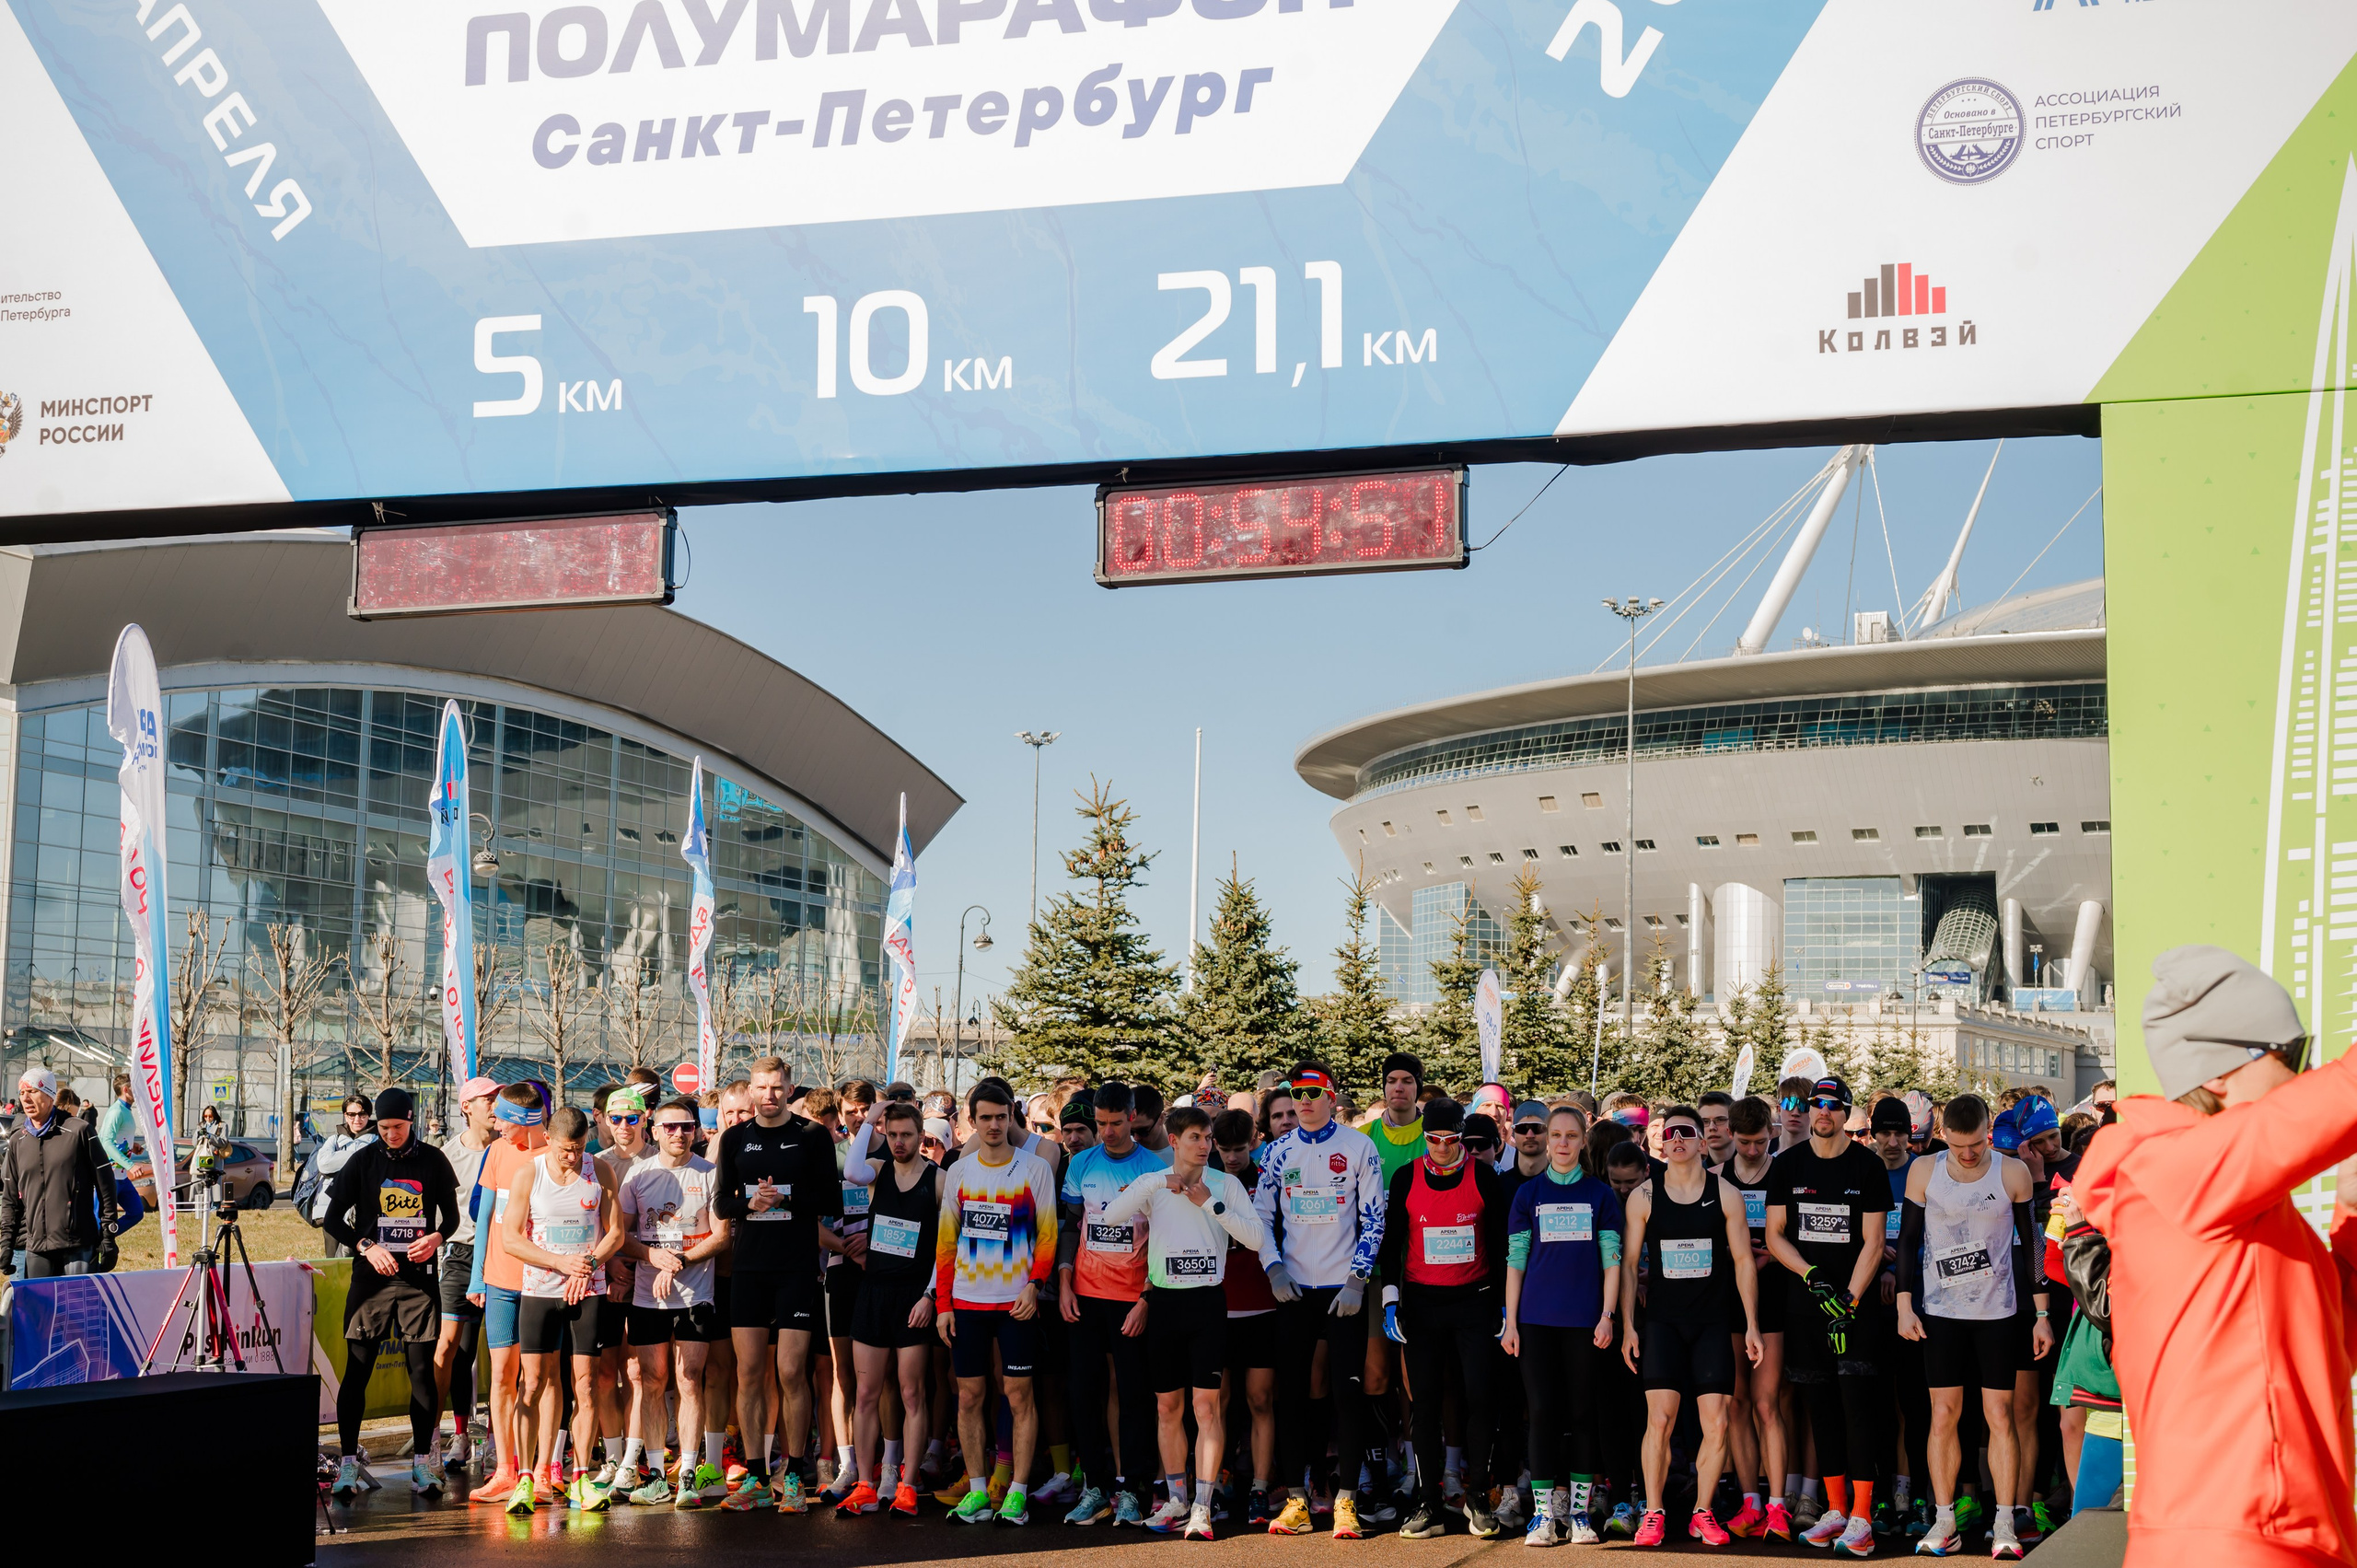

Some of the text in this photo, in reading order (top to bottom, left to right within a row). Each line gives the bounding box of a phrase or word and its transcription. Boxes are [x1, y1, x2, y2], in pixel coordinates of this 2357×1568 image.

[464, 0, 1355, 87] ПОЛУМАРА
[1925, 84, 2013, 119] ПЕТЕРБУРГСКИЙ СПОРТ
[2034, 85, 2161, 108] АССОЦИАЦИЯ
[531, 63, 1274, 169] Санкт-Петербург
[1943, 108, 1989, 121] Основано
[2035, 102, 2182, 129] ПЕТЕРБУРГСКИЙ
[1928, 122, 2014, 140] Санкт-Петербурге
[2035, 133, 2095, 150] СПОРТ
[1150, 259, 1343, 389] 21,1
[803, 289, 929, 399] 10
[472, 314, 544, 419] 5
[41, 394, 153, 418] МИНСПОРТ
[40, 423, 124, 445] РОССИИ
[1788, 1056, 1813, 1074] АРЕНА
[746, 1143, 763, 1153] Bite
[385, 1193, 420, 1212] Bite
[1299, 1199, 1326, 1210] 2061
[972, 1213, 999, 1225] 4077
[1553, 1214, 1577, 1225] 1212
[1809, 1215, 1838, 1227] 3259
[389, 1228, 413, 1238] 4718
[559, 1228, 584, 1238] 1779
[883, 1228, 907, 1242] 1852
[1096, 1226, 1122, 1238] 3225
[1436, 1238, 1463, 1249] 2244
[1177, 1258, 1207, 1270] 3650
[1673, 1252, 1700, 1263] 1760
[1948, 1254, 1977, 1271] 3742
